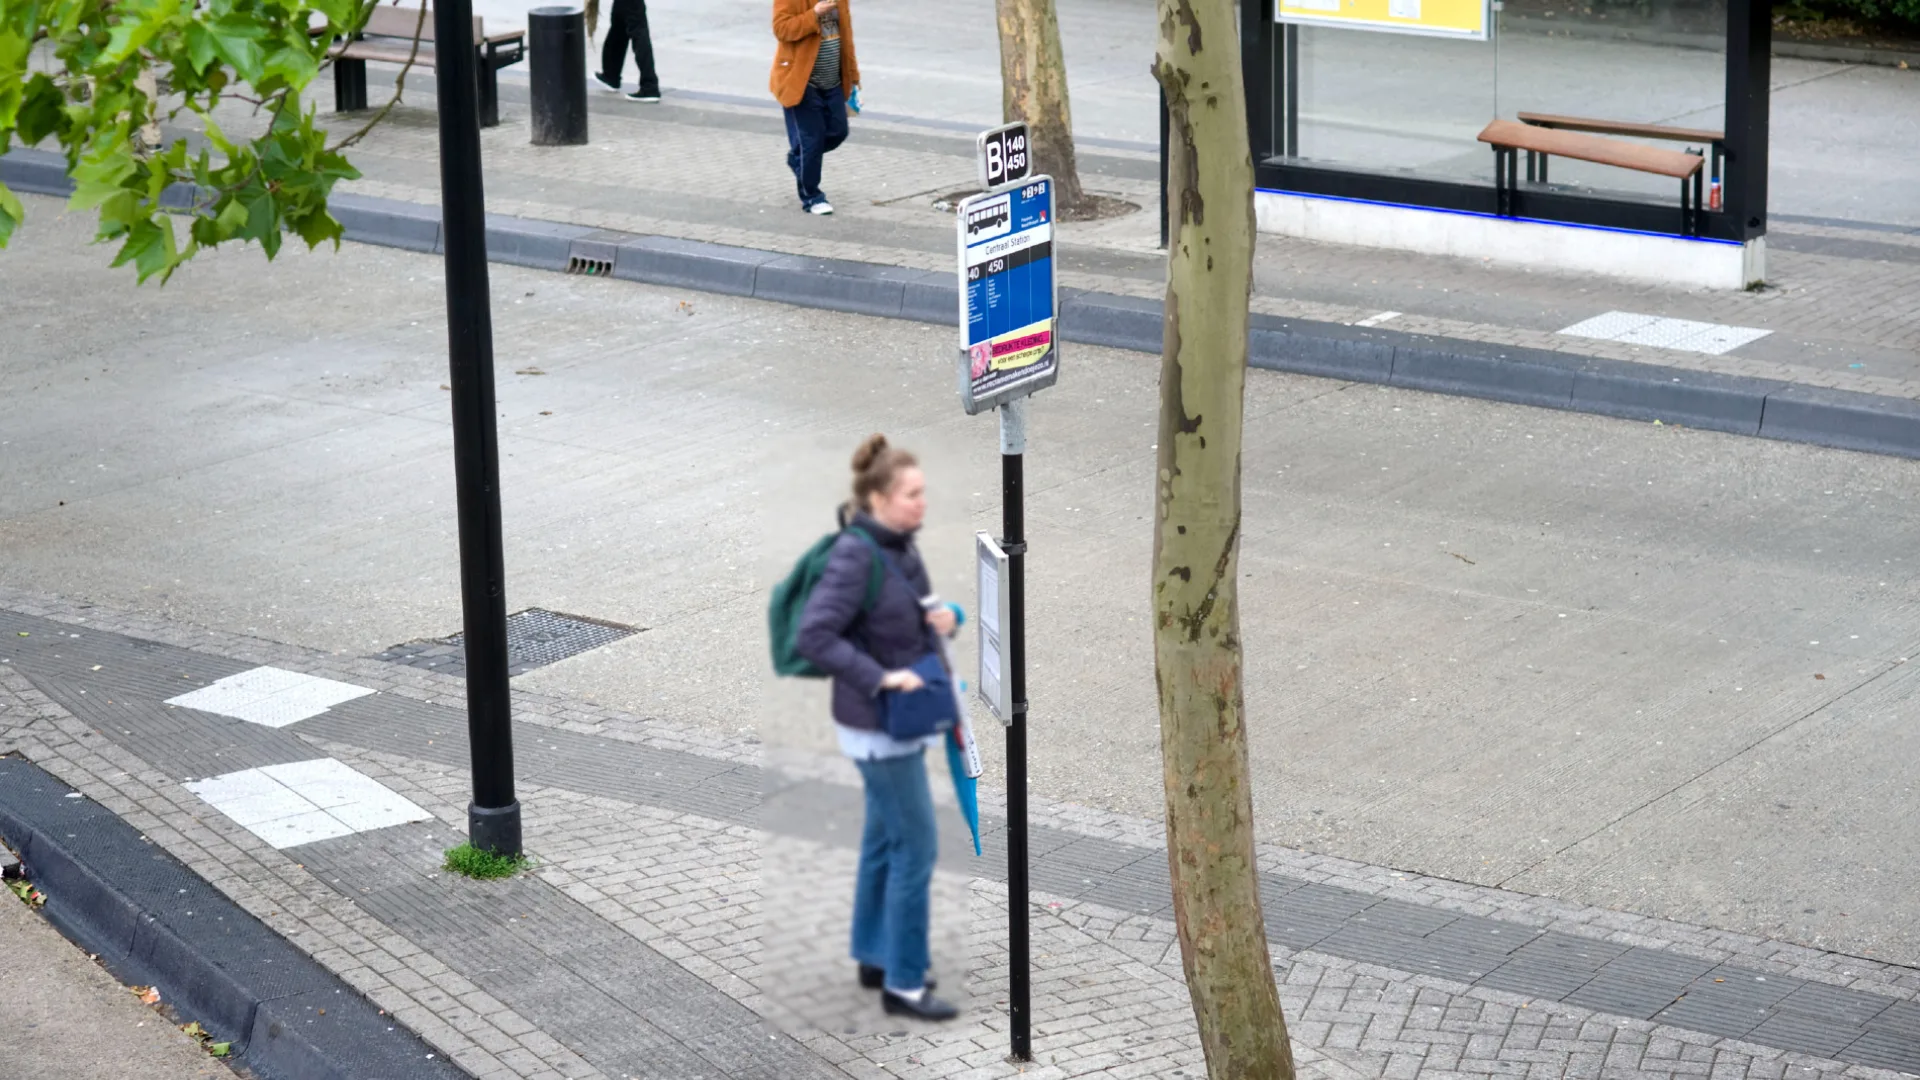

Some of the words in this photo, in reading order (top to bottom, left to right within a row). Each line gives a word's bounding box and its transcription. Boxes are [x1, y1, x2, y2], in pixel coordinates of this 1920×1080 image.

[1006, 135, 1025, 153] 140
[986, 141, 1003, 180] B
[1007, 153, 1025, 171] 450
[1022, 182, 1046, 199] 9292
[985, 239, 1010, 255] Centraal
[1011, 235, 1031, 248] Station
[988, 259, 1004, 273] 450
